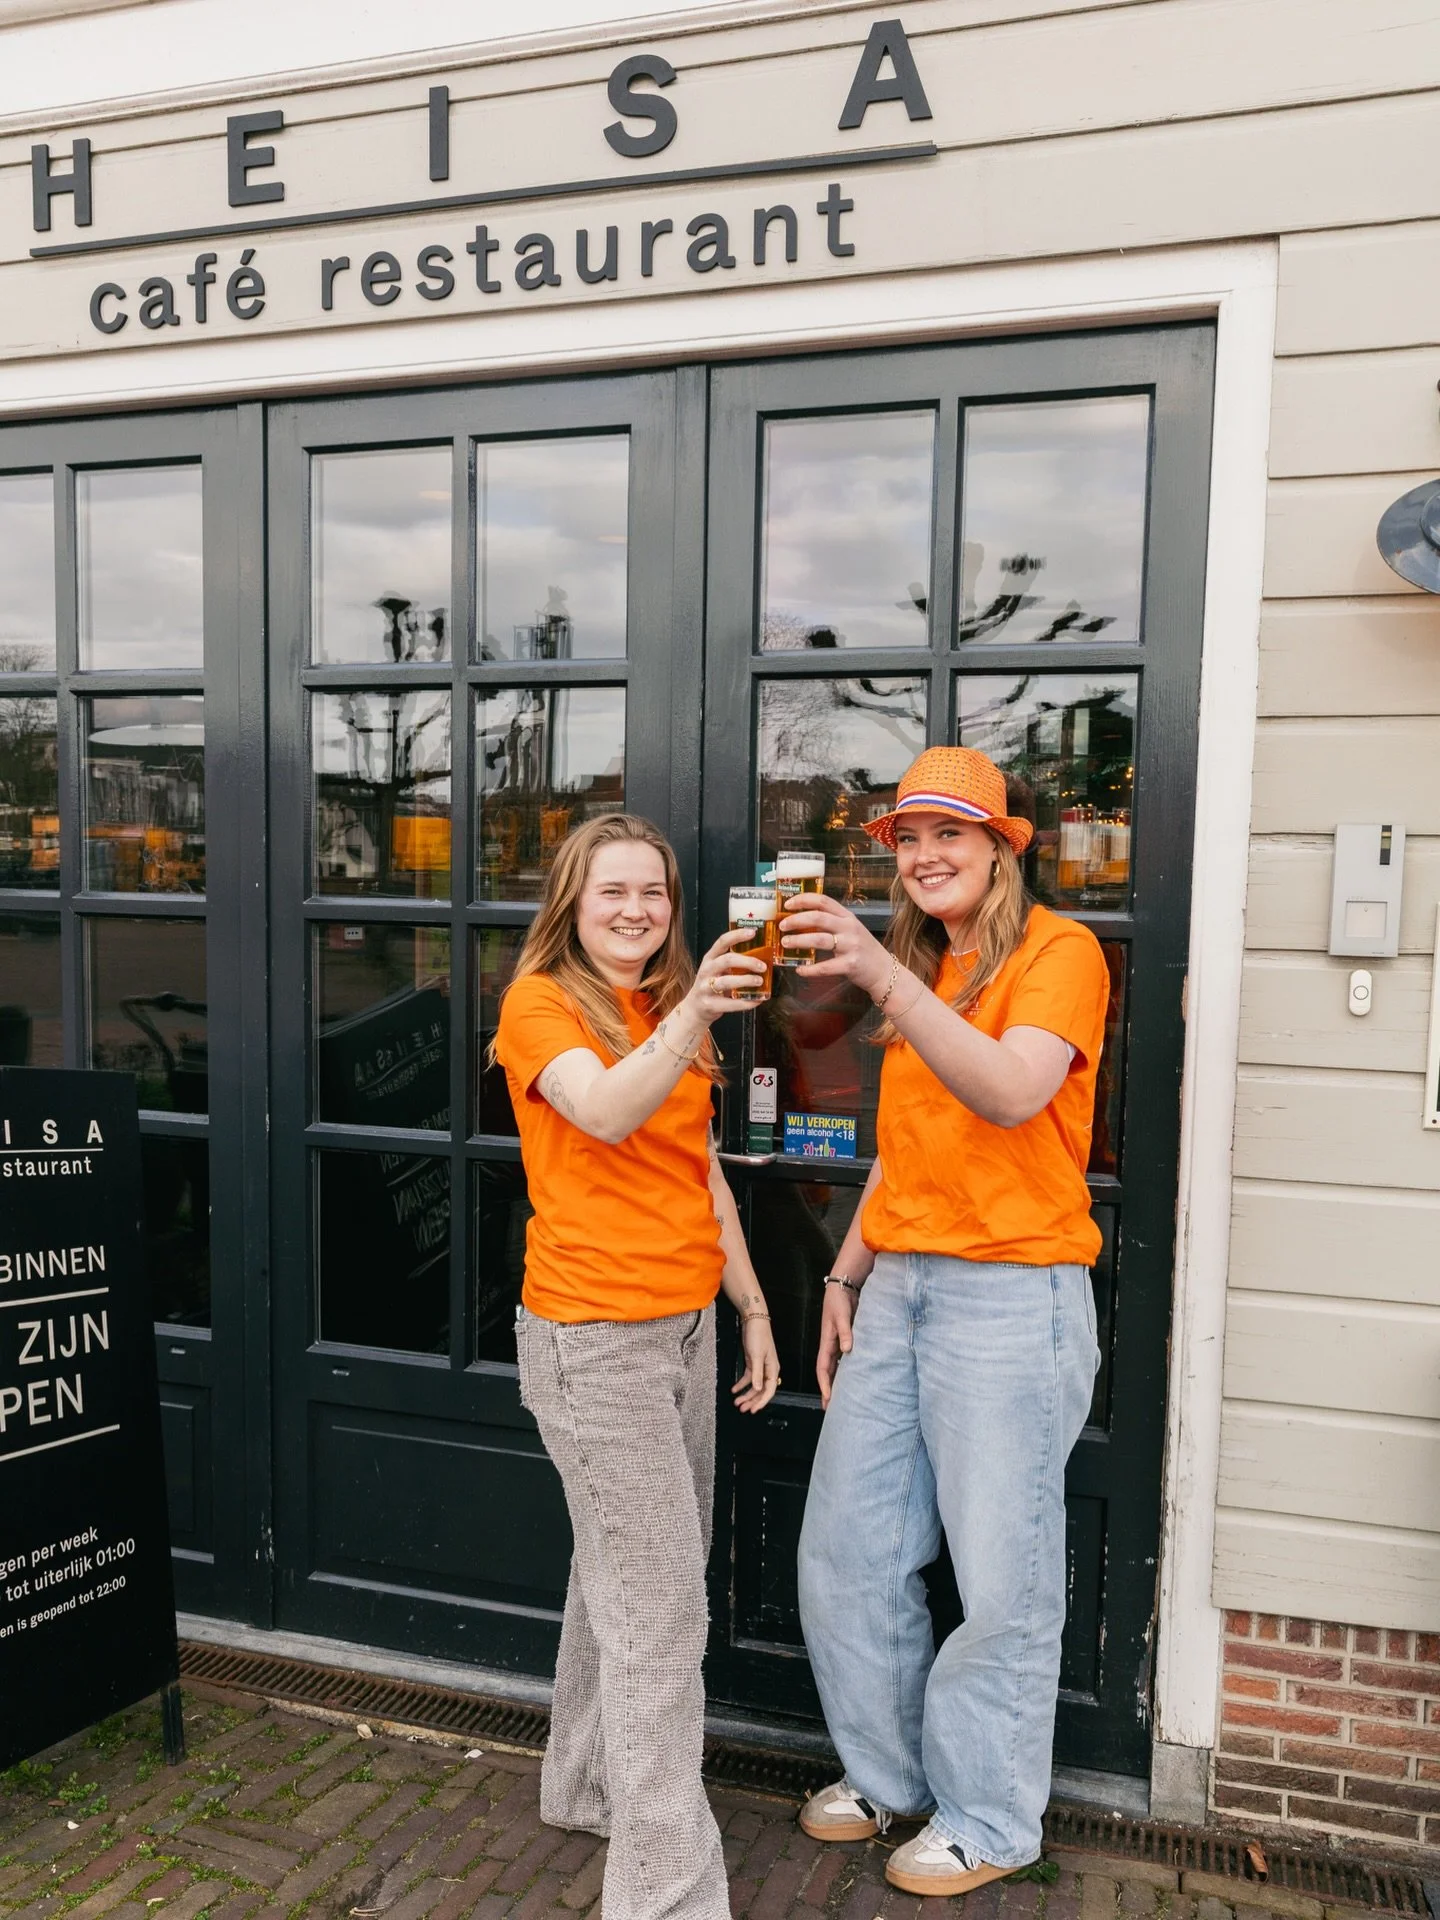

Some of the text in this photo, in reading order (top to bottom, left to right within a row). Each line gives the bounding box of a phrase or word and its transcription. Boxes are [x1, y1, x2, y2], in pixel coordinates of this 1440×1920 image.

[31, 19, 932, 232] HEISA
[89, 184, 855, 334] café restaurant
[786, 1127, 855, 1141] geen alcohol <18
[787, 1115, 855, 1130] WIJ VERKOPEN
[0, 1245, 106, 1283] BINNEN
[18, 1310, 110, 1365] ZIJN
[0, 1373, 84, 1432] PEN
[5, 1537, 136, 1602] tot uiterlijk 01:00
[31, 1543, 56, 1568] per
[59, 1526, 99, 1553] week
[17, 1618, 27, 1631] is
[30, 1596, 76, 1628] geopend
[78, 1589, 95, 1605] tot
[96, 1575, 127, 1599] 22:00
